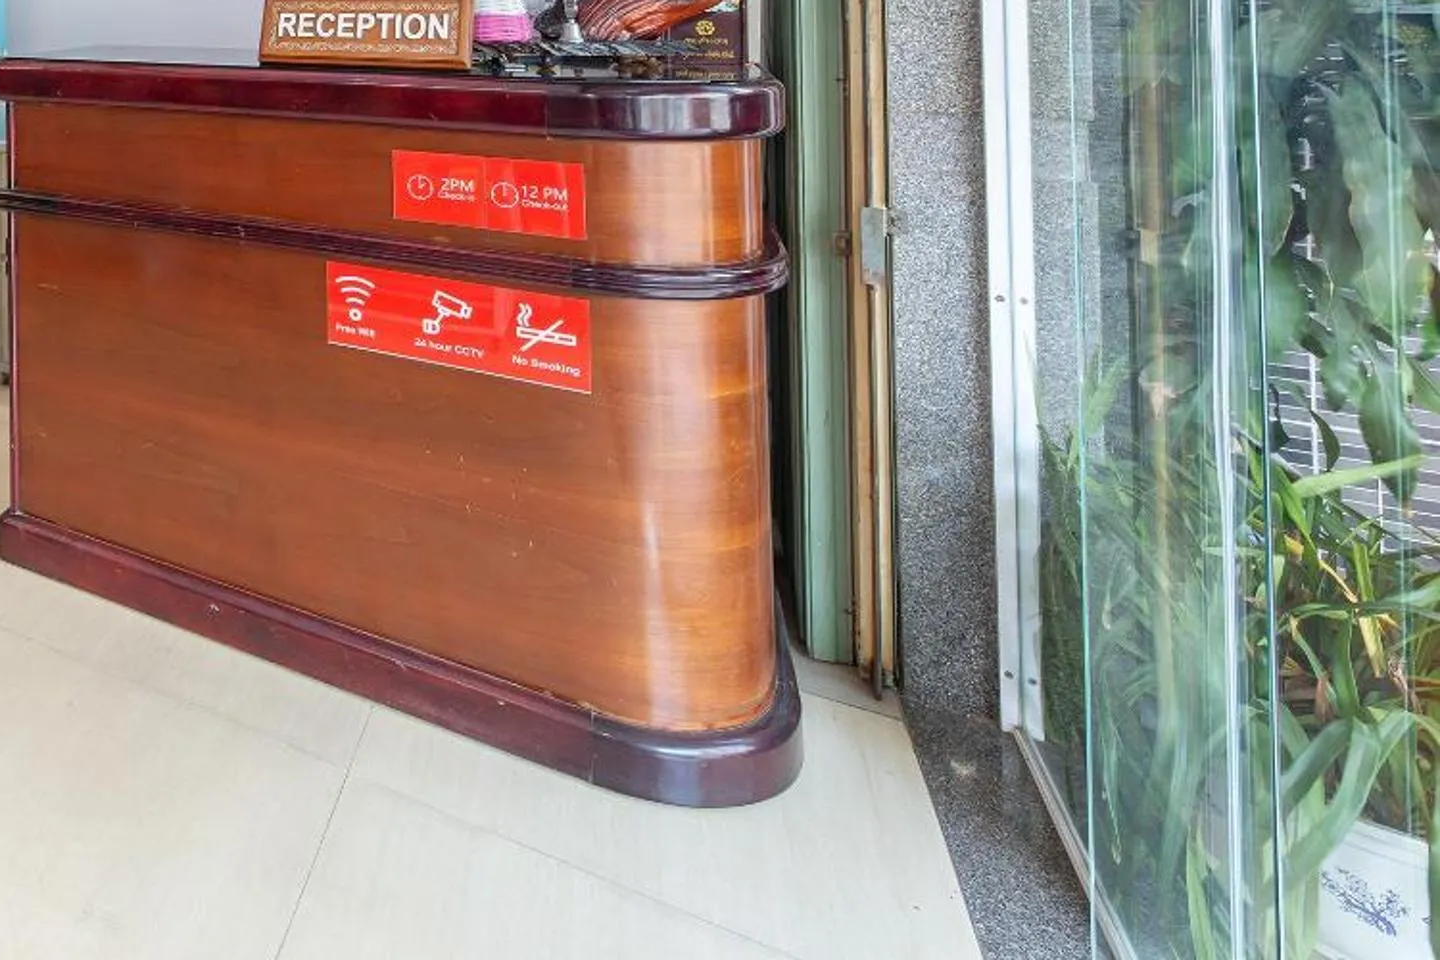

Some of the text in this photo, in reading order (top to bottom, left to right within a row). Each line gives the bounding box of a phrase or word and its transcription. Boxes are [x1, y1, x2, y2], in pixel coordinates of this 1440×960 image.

[278, 12, 449, 40] RECEPTION
[521, 185, 568, 201] 12 PM
[429, 340, 452, 352] hour
[455, 345, 485, 359] CCTV
[512, 354, 581, 378] No Smoking
